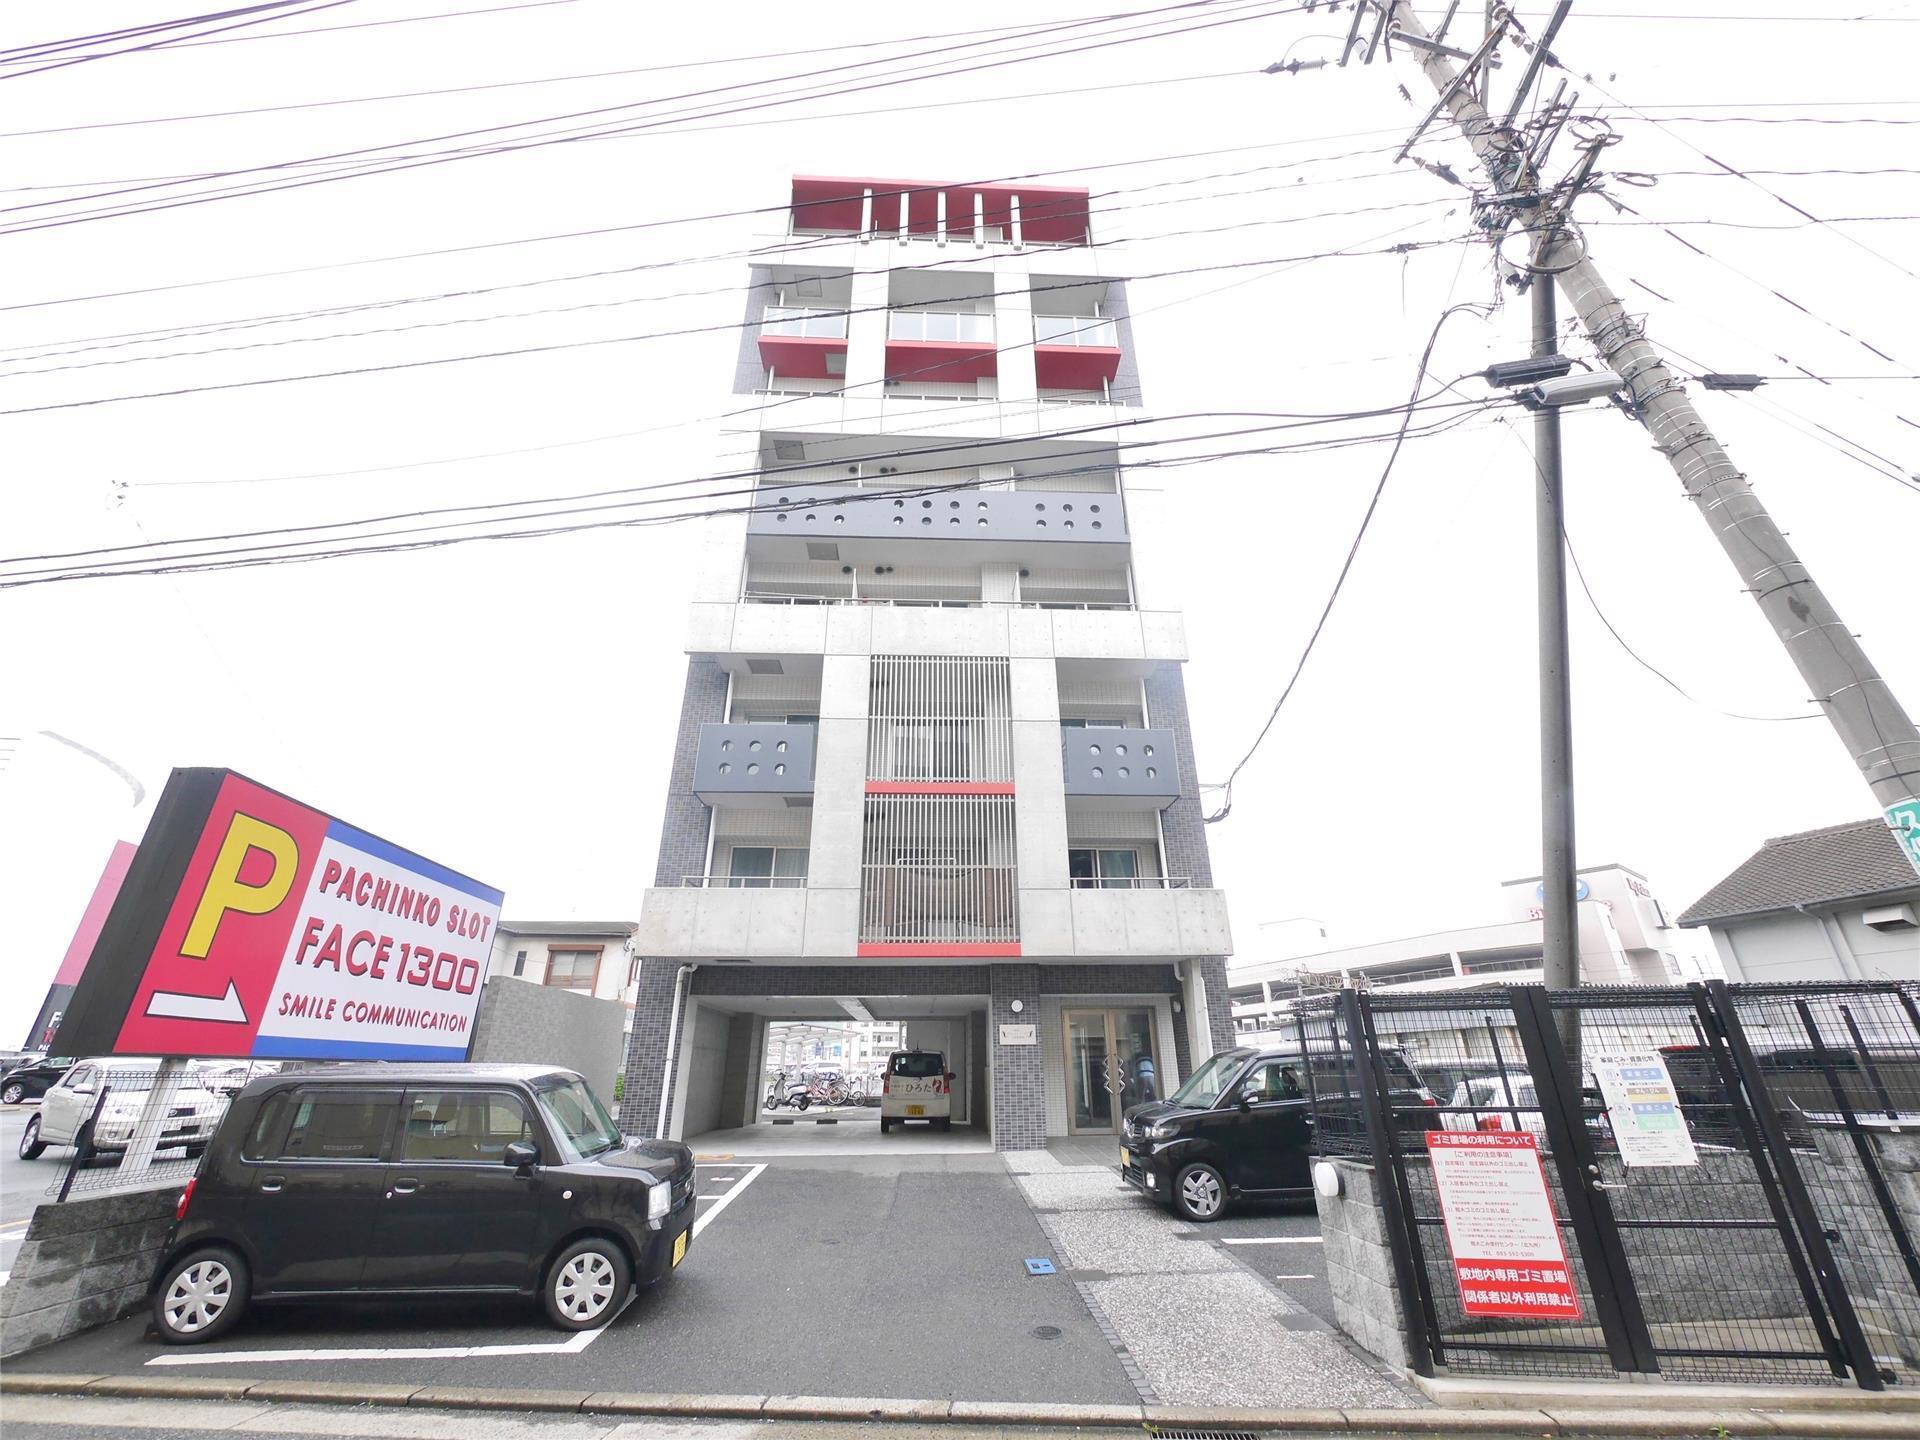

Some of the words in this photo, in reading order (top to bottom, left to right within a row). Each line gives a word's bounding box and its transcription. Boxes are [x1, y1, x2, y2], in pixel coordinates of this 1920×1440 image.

[178, 810, 300, 960] P
[319, 858, 441, 927] PACHINKO
[446, 904, 491, 943] SLOT
[278, 992, 337, 1020] SMILE
[342, 1001, 468, 1033] COMMUNICATION
[1432, 1134, 1532, 1146] ゴミ置場の利用について
[1459, 1267, 1568, 1284] 敷地内専用ゴミ置場
[1464, 1289, 1574, 1307] 関係者以外利用禁止
